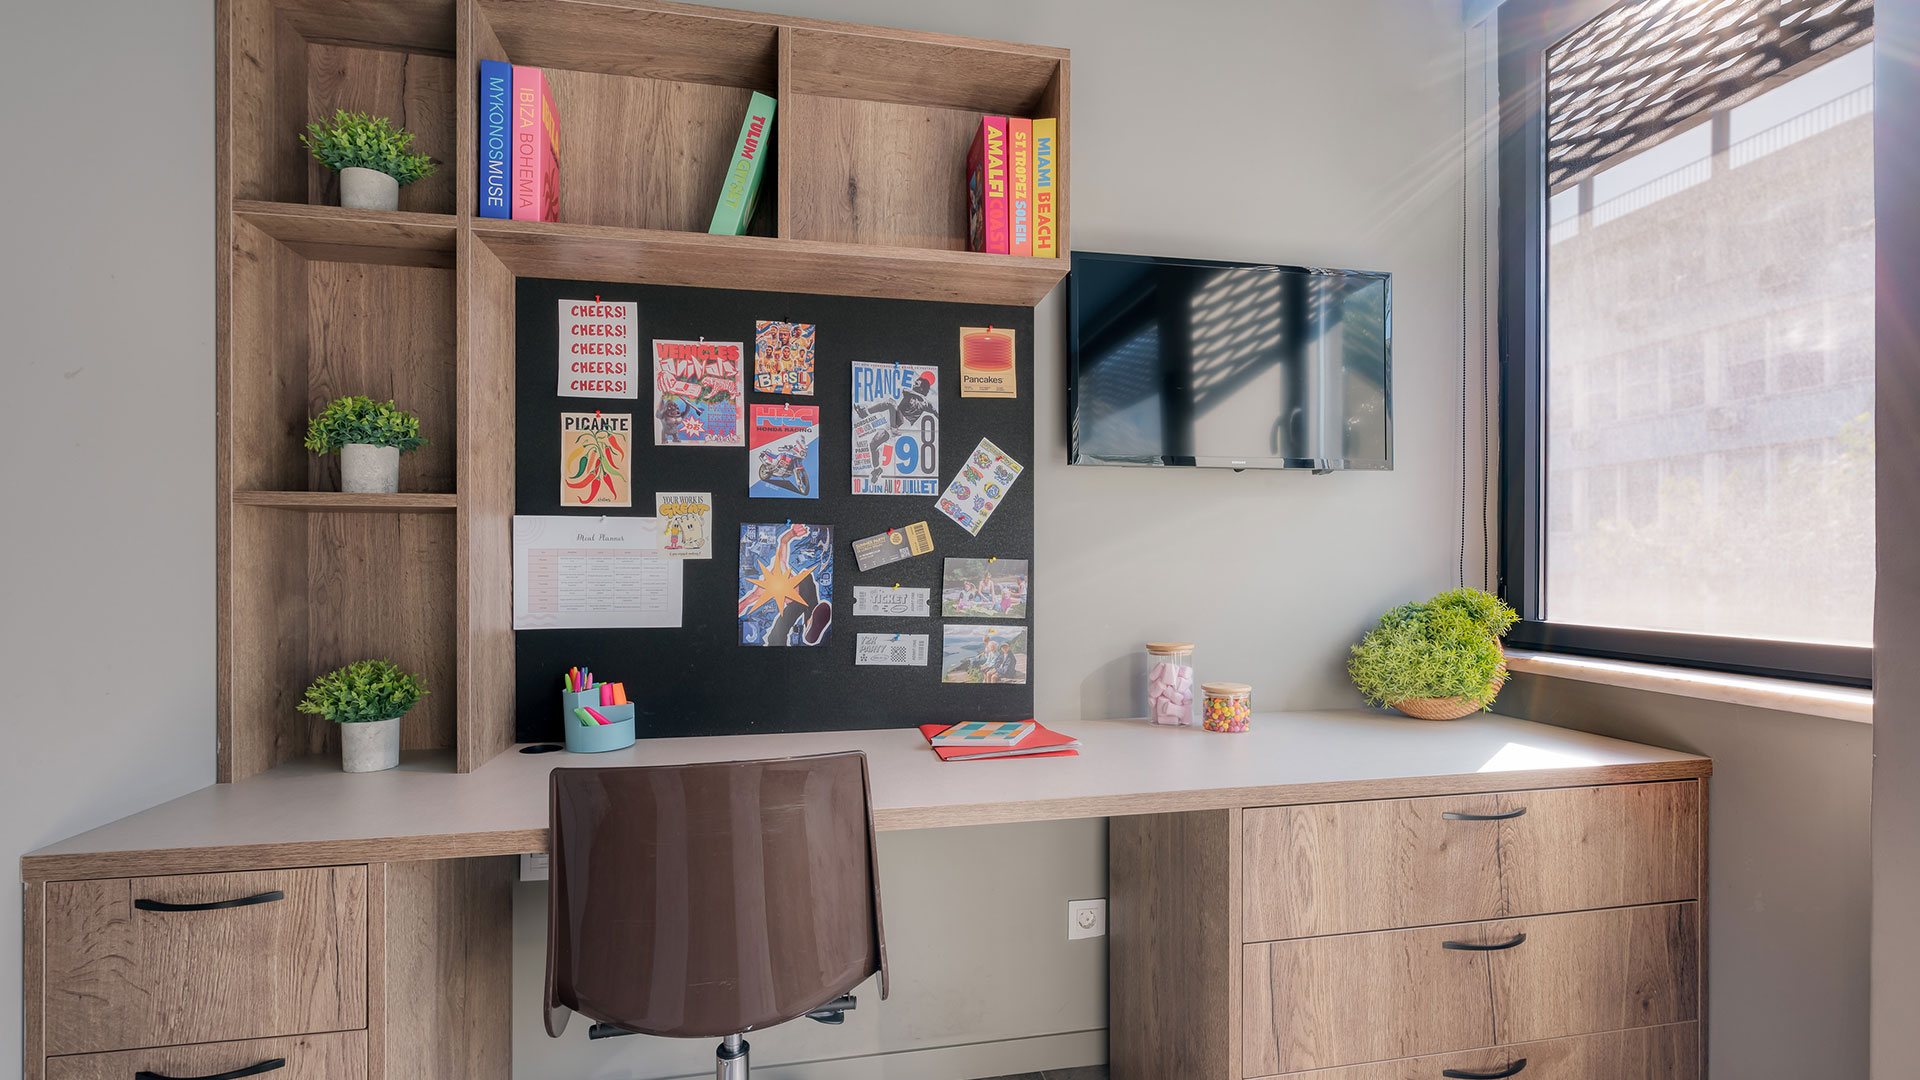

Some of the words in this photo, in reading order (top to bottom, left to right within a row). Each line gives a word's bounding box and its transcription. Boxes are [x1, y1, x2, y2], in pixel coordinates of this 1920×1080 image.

[520, 87, 534, 128] IBIZA
[741, 115, 766, 160] TULUM
[519, 132, 534, 209] BOHEMIA
[987, 125, 1004, 198] AMALFI
[1037, 137, 1051, 187] MIAMI
[1015, 150, 1026, 199] TROPEZ
[725, 159, 751, 210] GYPSET
[989, 199, 1005, 252] COAST
[1015, 200, 1026, 245] SOLEIL
[1037, 192, 1051, 249] BEACH
[571, 305, 626, 320] CHEERS!
[571, 324, 626, 339] CHEERS!
[571, 343, 626, 357] CHEERS!
[656, 343, 740, 361] VEHICLES
[571, 361, 626, 376] CHEERS!
[570, 380, 626, 394] CHEERS!
[758, 370, 807, 388] BRASIL
[854, 367, 915, 403] FRANCE
[963, 375, 1003, 384] Pancakes
[565, 417, 628, 431] PICANTE
[756, 406, 814, 427] HRC
[853, 479, 861, 493] 10
[884, 479, 893, 494] AU
[894, 479, 901, 494] 12
[902, 480, 937, 494] JUILLET
[662, 495, 679, 504] YOUR
[679, 495, 697, 504] WORK
[697, 495, 704, 504] IS
[659, 502, 710, 519] GREAT
[576, 533, 595, 541] Meal
[599, 533, 625, 541] Planner
[871, 594, 908, 605] TICKET
[859, 645, 887, 653] PARTY
